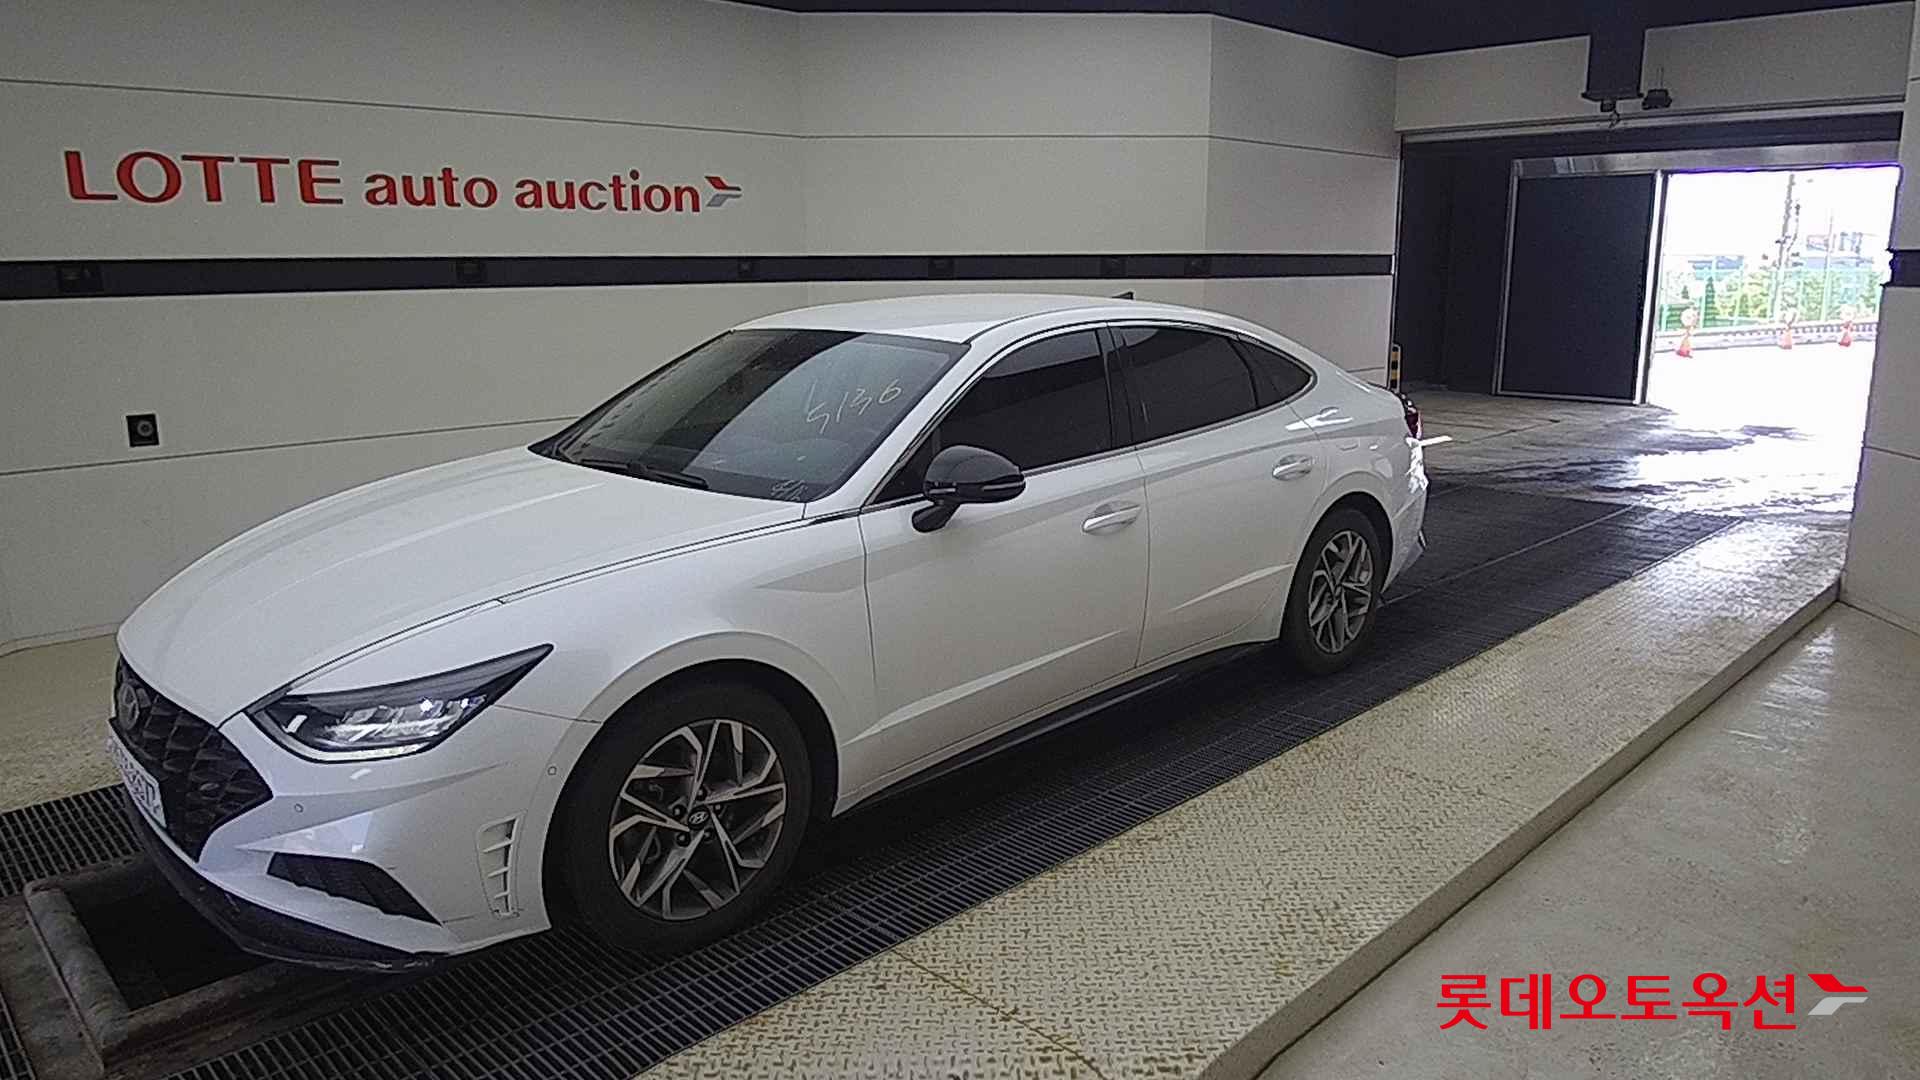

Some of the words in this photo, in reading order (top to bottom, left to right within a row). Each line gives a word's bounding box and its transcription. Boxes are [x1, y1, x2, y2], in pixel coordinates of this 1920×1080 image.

[65, 150, 343, 204] LOTTE
[365, 166, 499, 208] auto
[514, 169, 702, 213] auction
